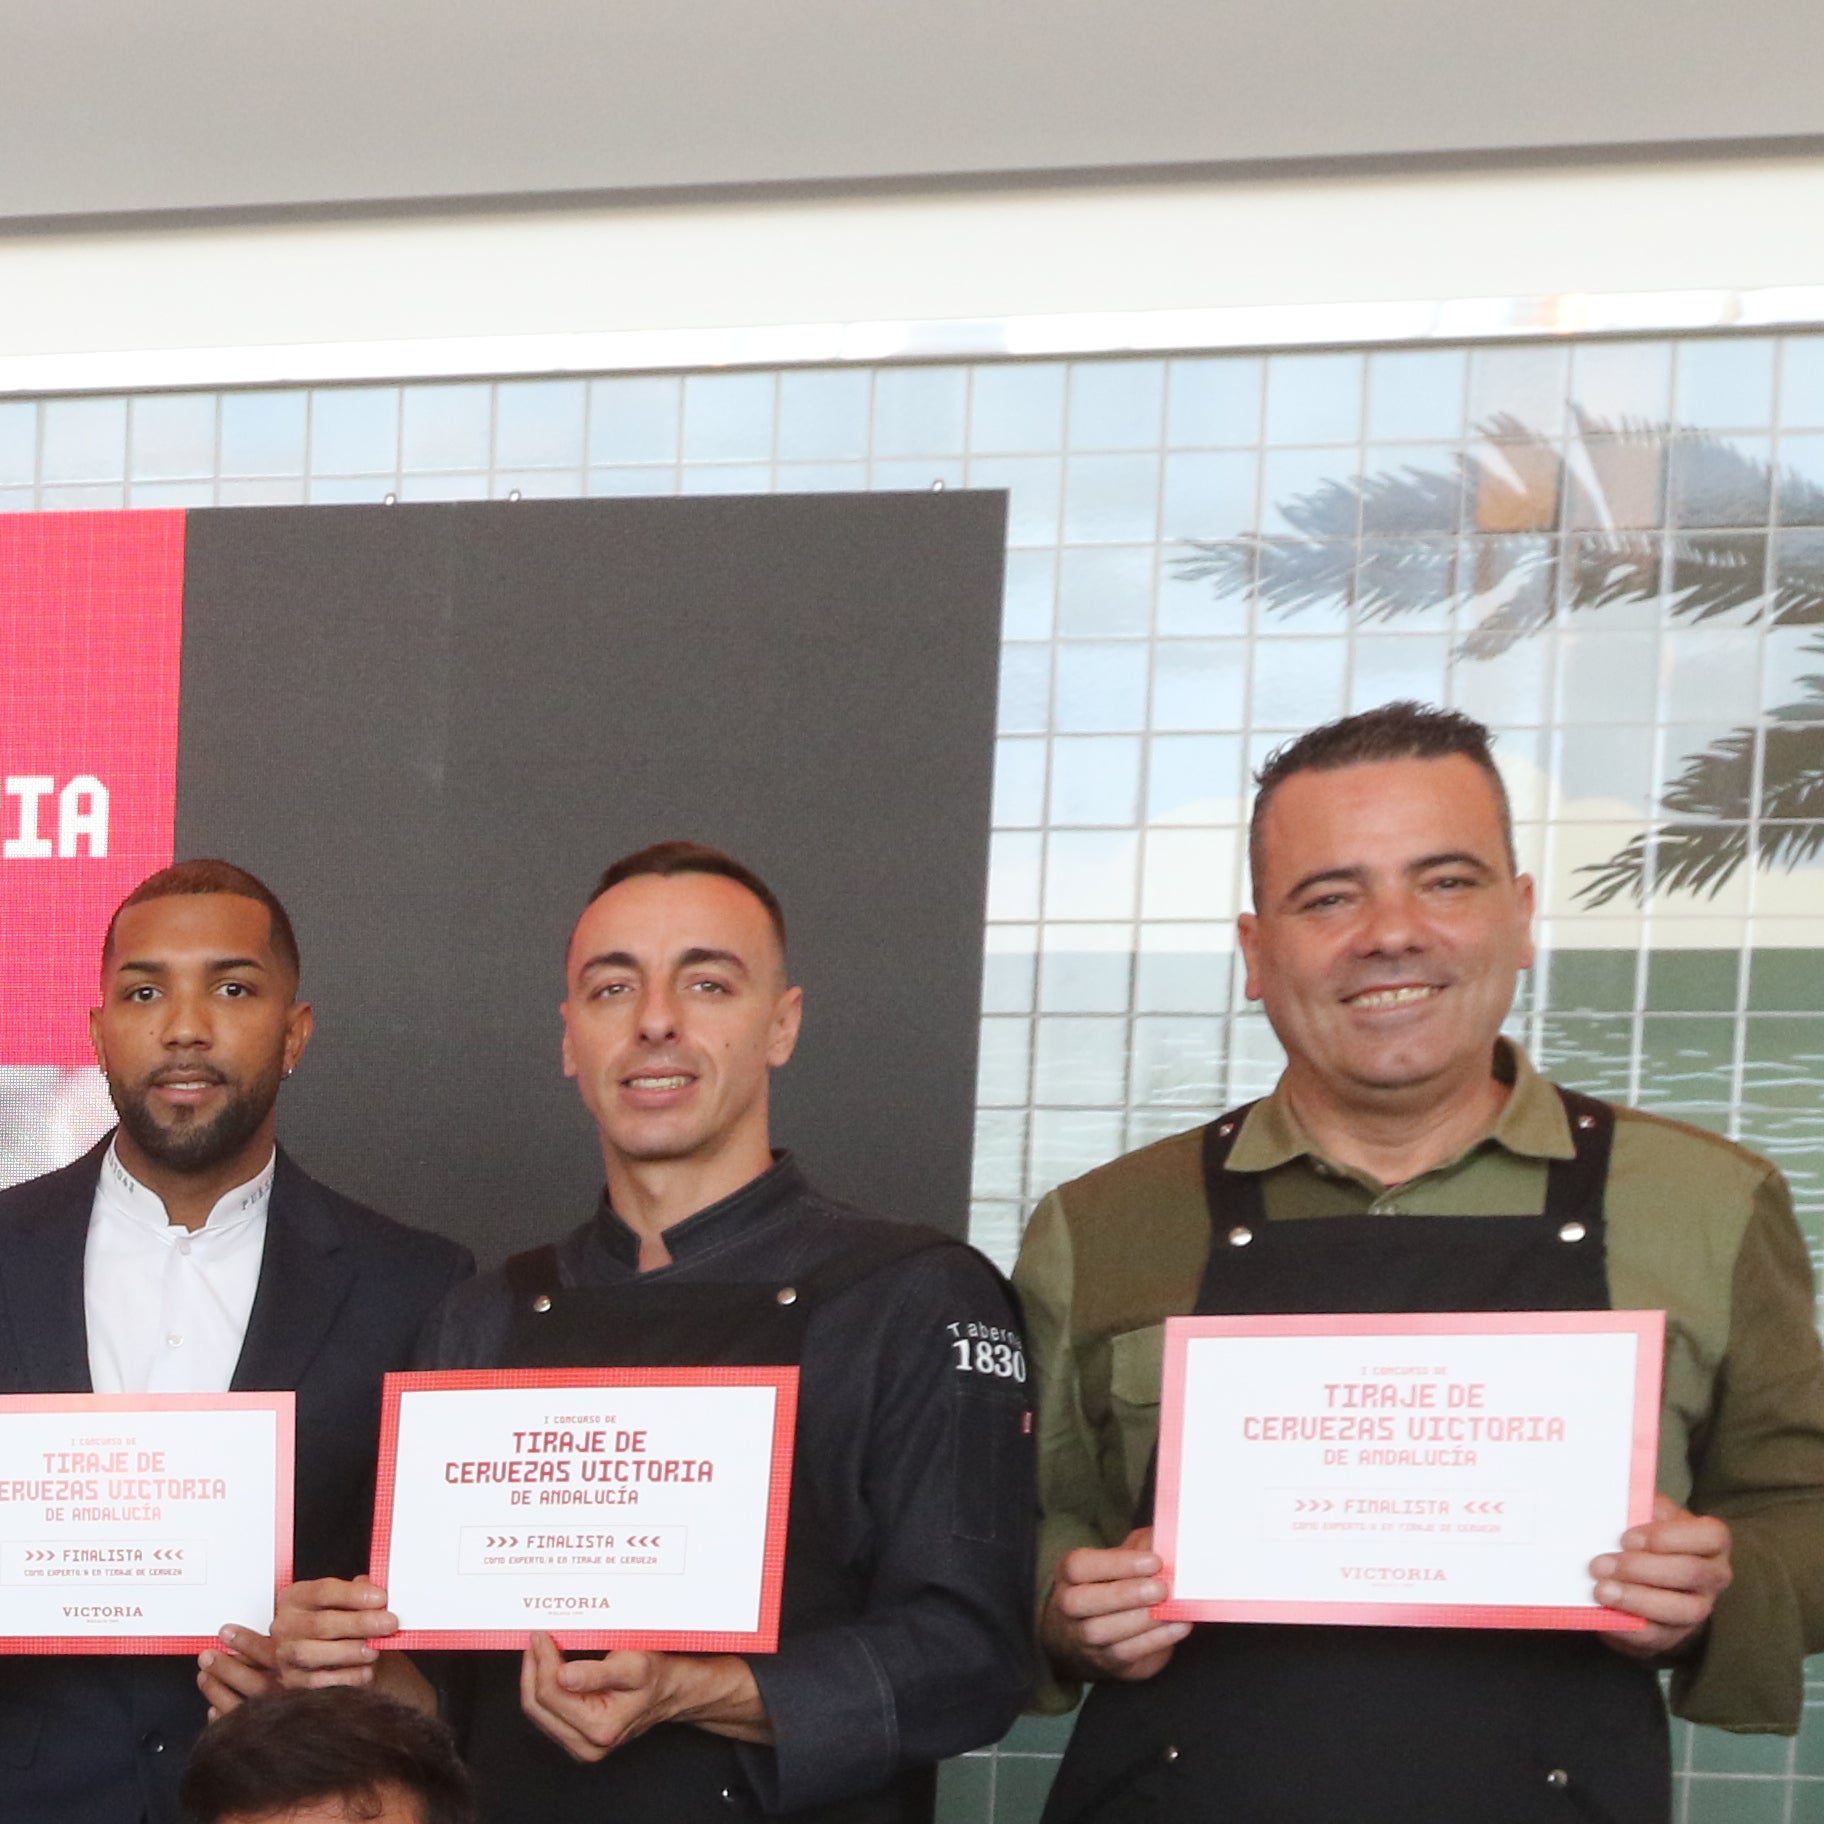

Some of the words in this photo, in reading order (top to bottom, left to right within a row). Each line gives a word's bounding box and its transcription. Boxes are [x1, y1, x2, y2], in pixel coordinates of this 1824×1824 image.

[953, 1339, 1026, 1382] 1830
[1322, 1384, 1436, 1407] TIRAJE
[1447, 1383, 1485, 1407] DE
[1243, 1416, 1395, 1440] CERVEZAS
[1407, 1417, 1566, 1441] VICTORIA
[511, 1431, 606, 1453] TIRAJE
[615, 1430, 647, 1452] DE
[43, 1452, 128, 1473] TIRAJE
[137, 1452, 165, 1472] DE
[444, 1461, 571, 1483] CERVEZAS
[581, 1459, 714, 1482] VICTORIA
[108, 1478, 226, 1499] VICTORIA
[510, 1490, 532, 1504] DE
[539, 1486, 639, 1504] ANDALUCÍA
[45, 1507, 64, 1521] DE
[72, 1503, 161, 1521] ANDALUCÍA
[526, 1535, 615, 1548] FINALISTA
[62, 1549, 143, 1561] FINALISTA
[521, 1596, 611, 1608] VICTORIA
